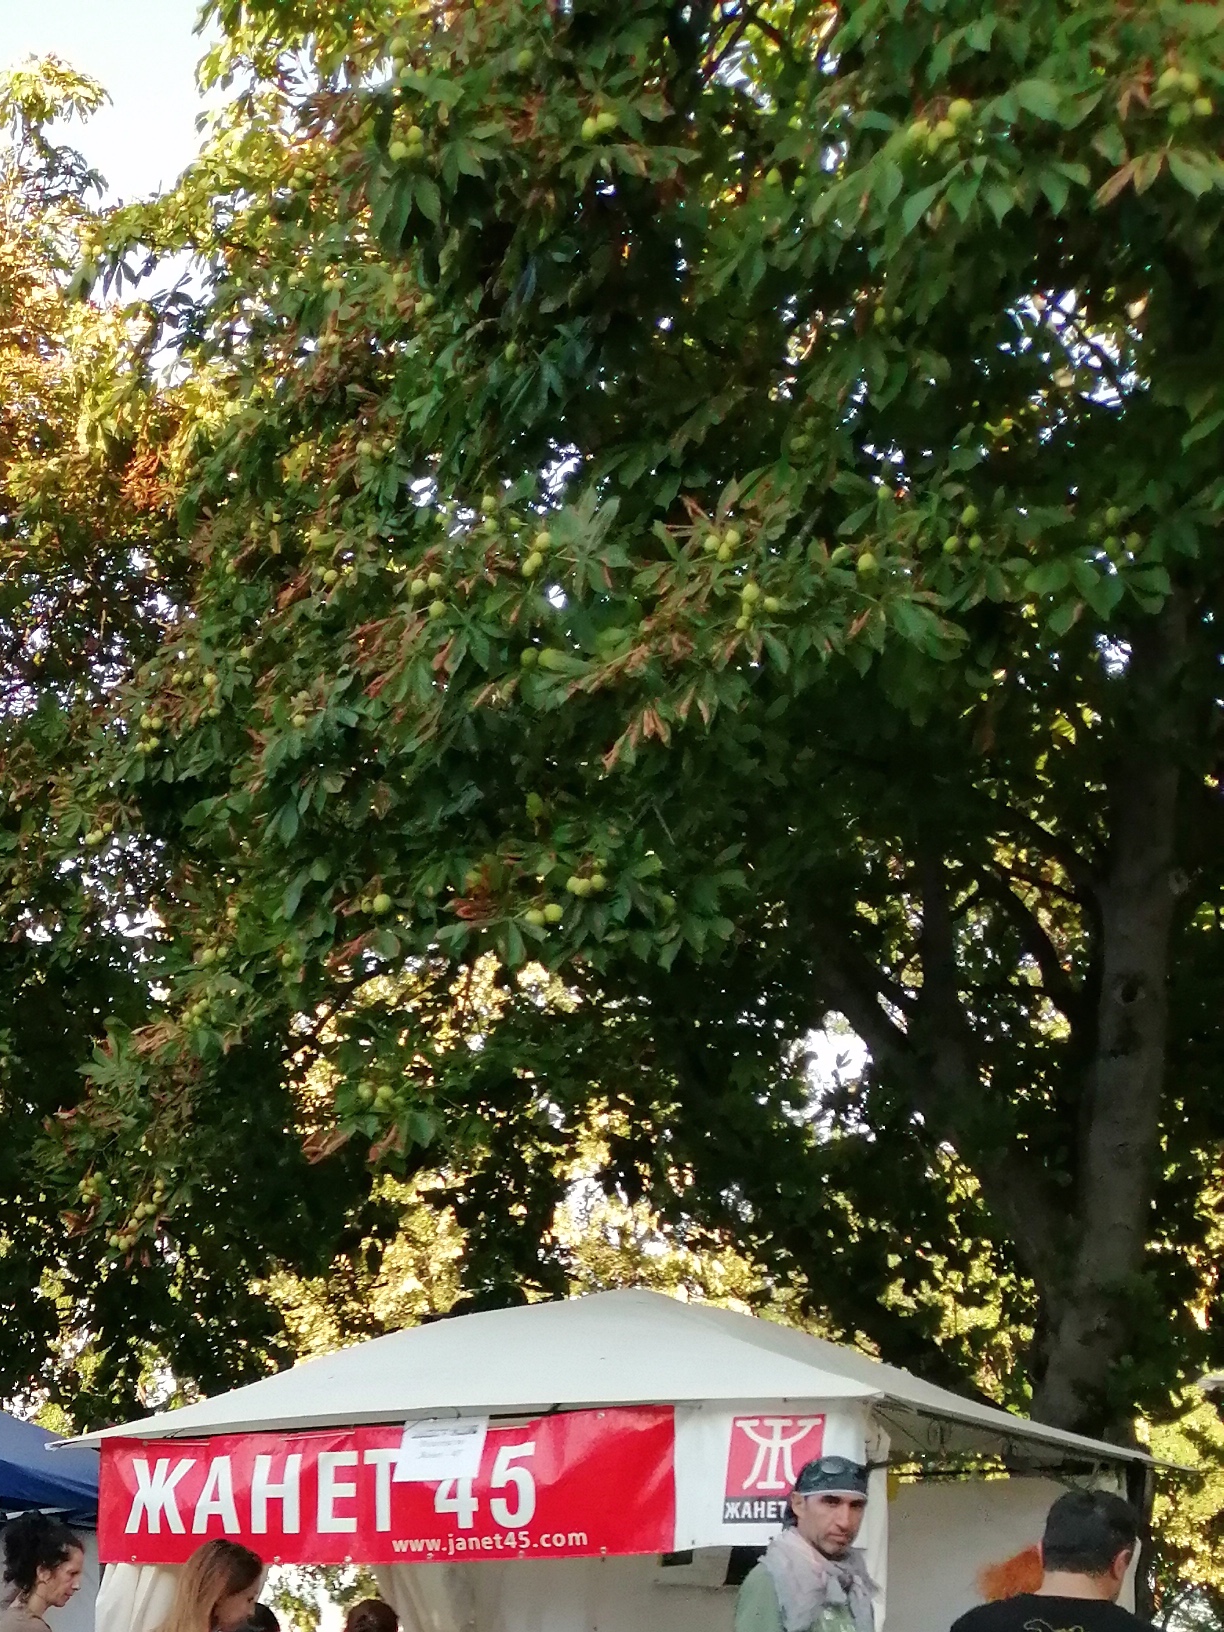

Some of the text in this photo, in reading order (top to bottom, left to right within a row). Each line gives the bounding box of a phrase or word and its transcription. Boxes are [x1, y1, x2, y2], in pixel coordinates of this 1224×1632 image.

[124, 1447, 398, 1534] ЖАНЕТ
[724, 1501, 788, 1519] ЖАНЕТ
[392, 1531, 588, 1555] www.janet45.com
